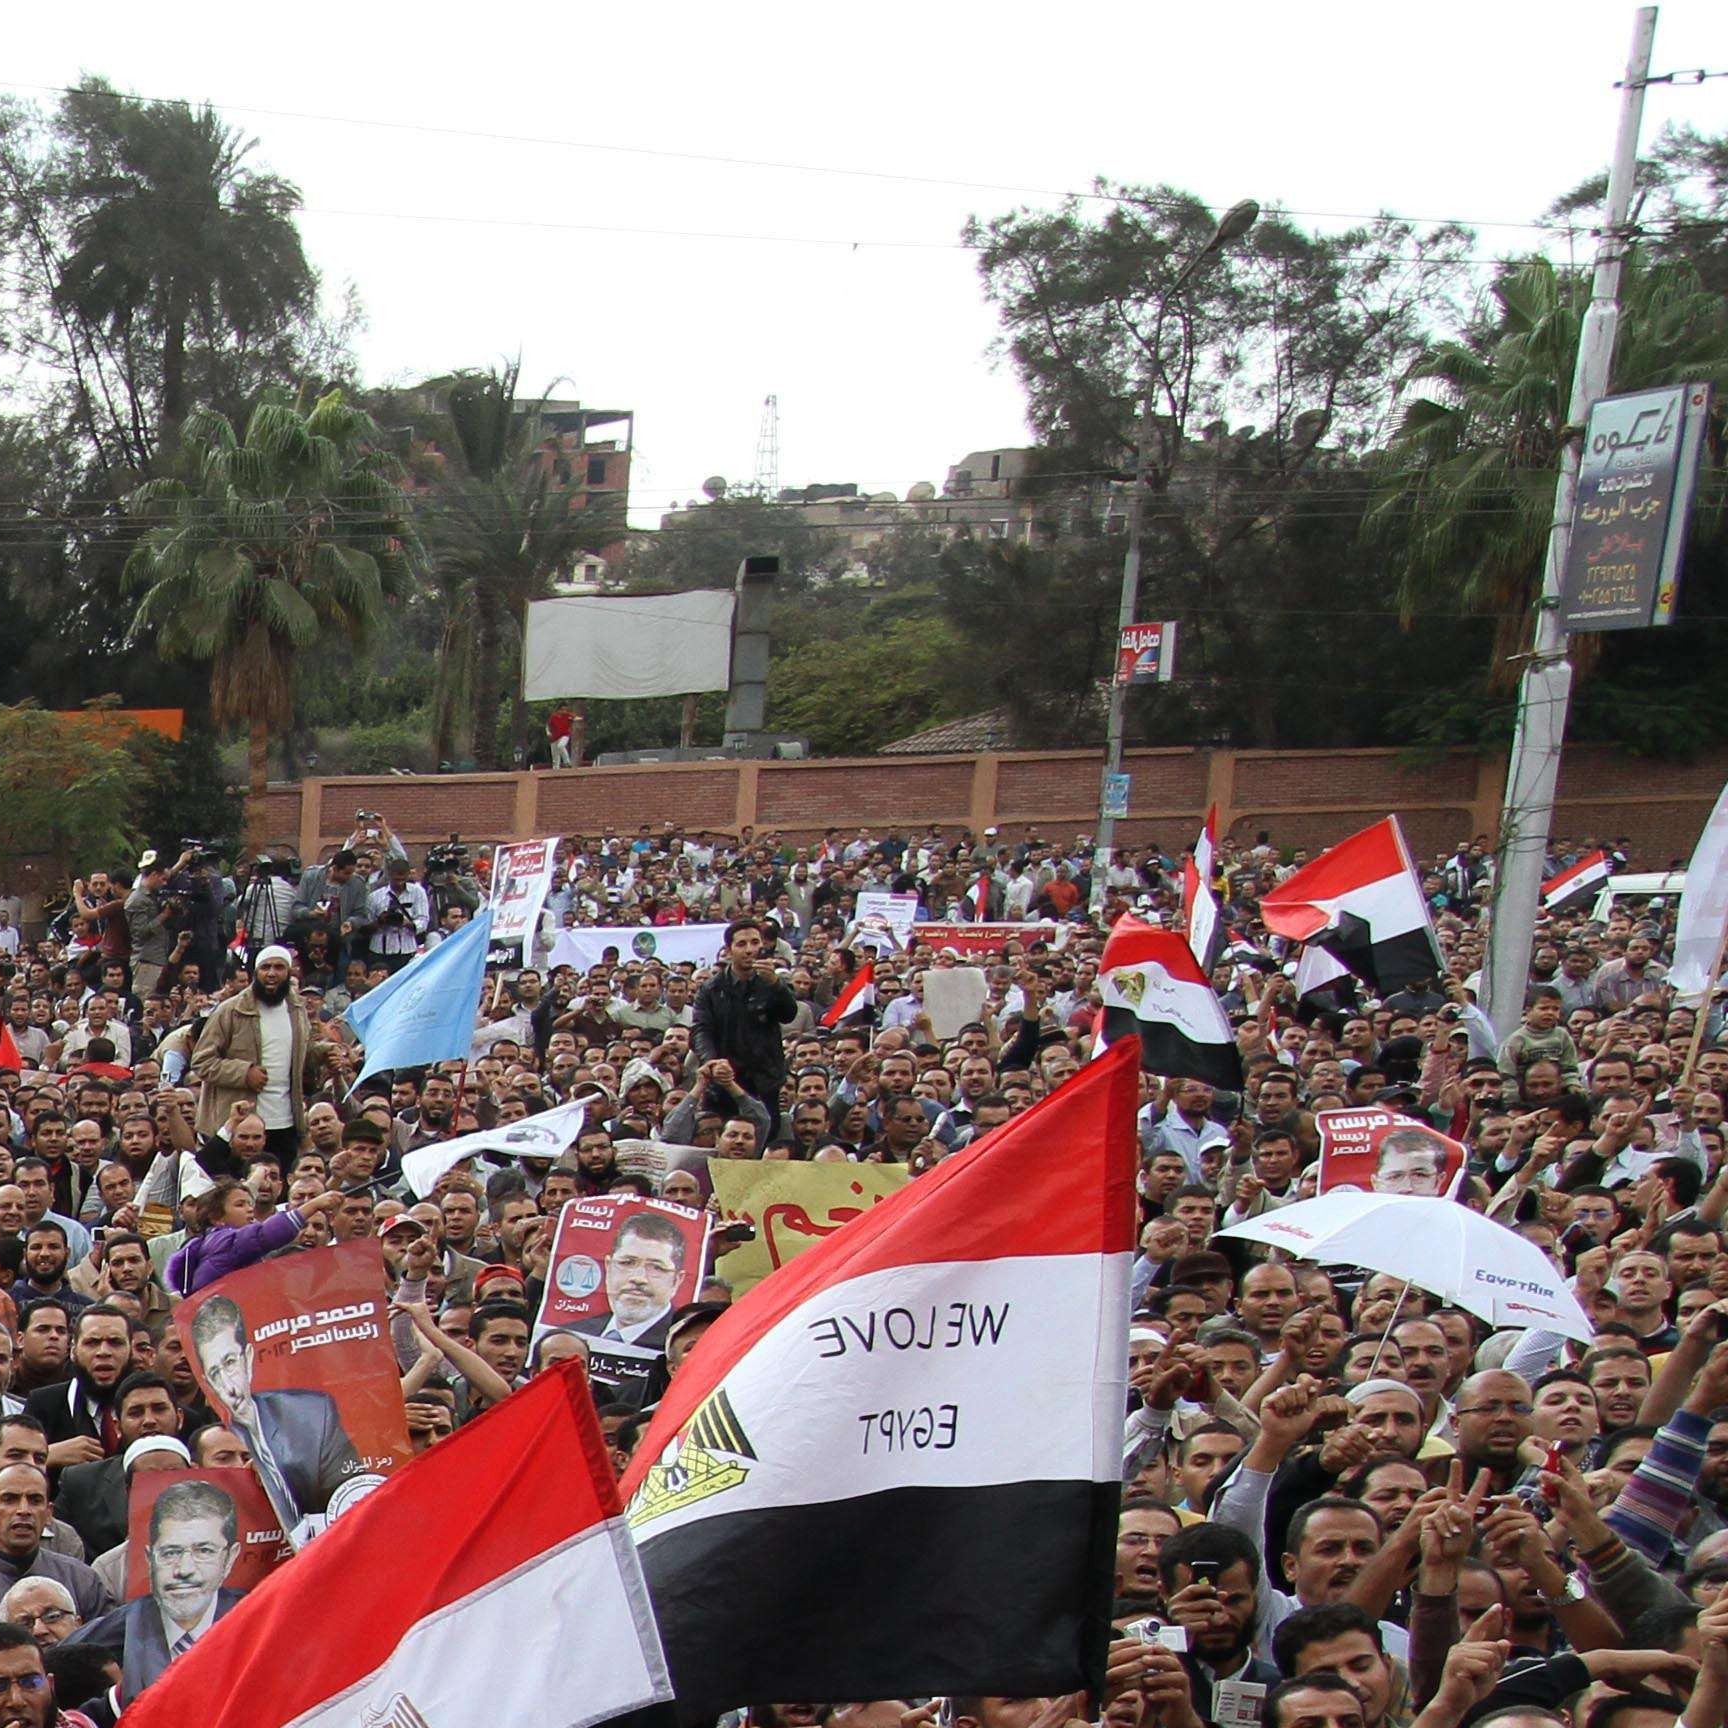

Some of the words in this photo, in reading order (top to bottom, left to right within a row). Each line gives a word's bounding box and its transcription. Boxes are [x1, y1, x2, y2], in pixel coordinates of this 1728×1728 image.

[1331, 1143, 1372, 1157] لمصر
[570, 1216, 612, 1231] لمصر
[315, 1302, 375, 1325] محمد
[289, 1331, 335, 1354] لمصر
